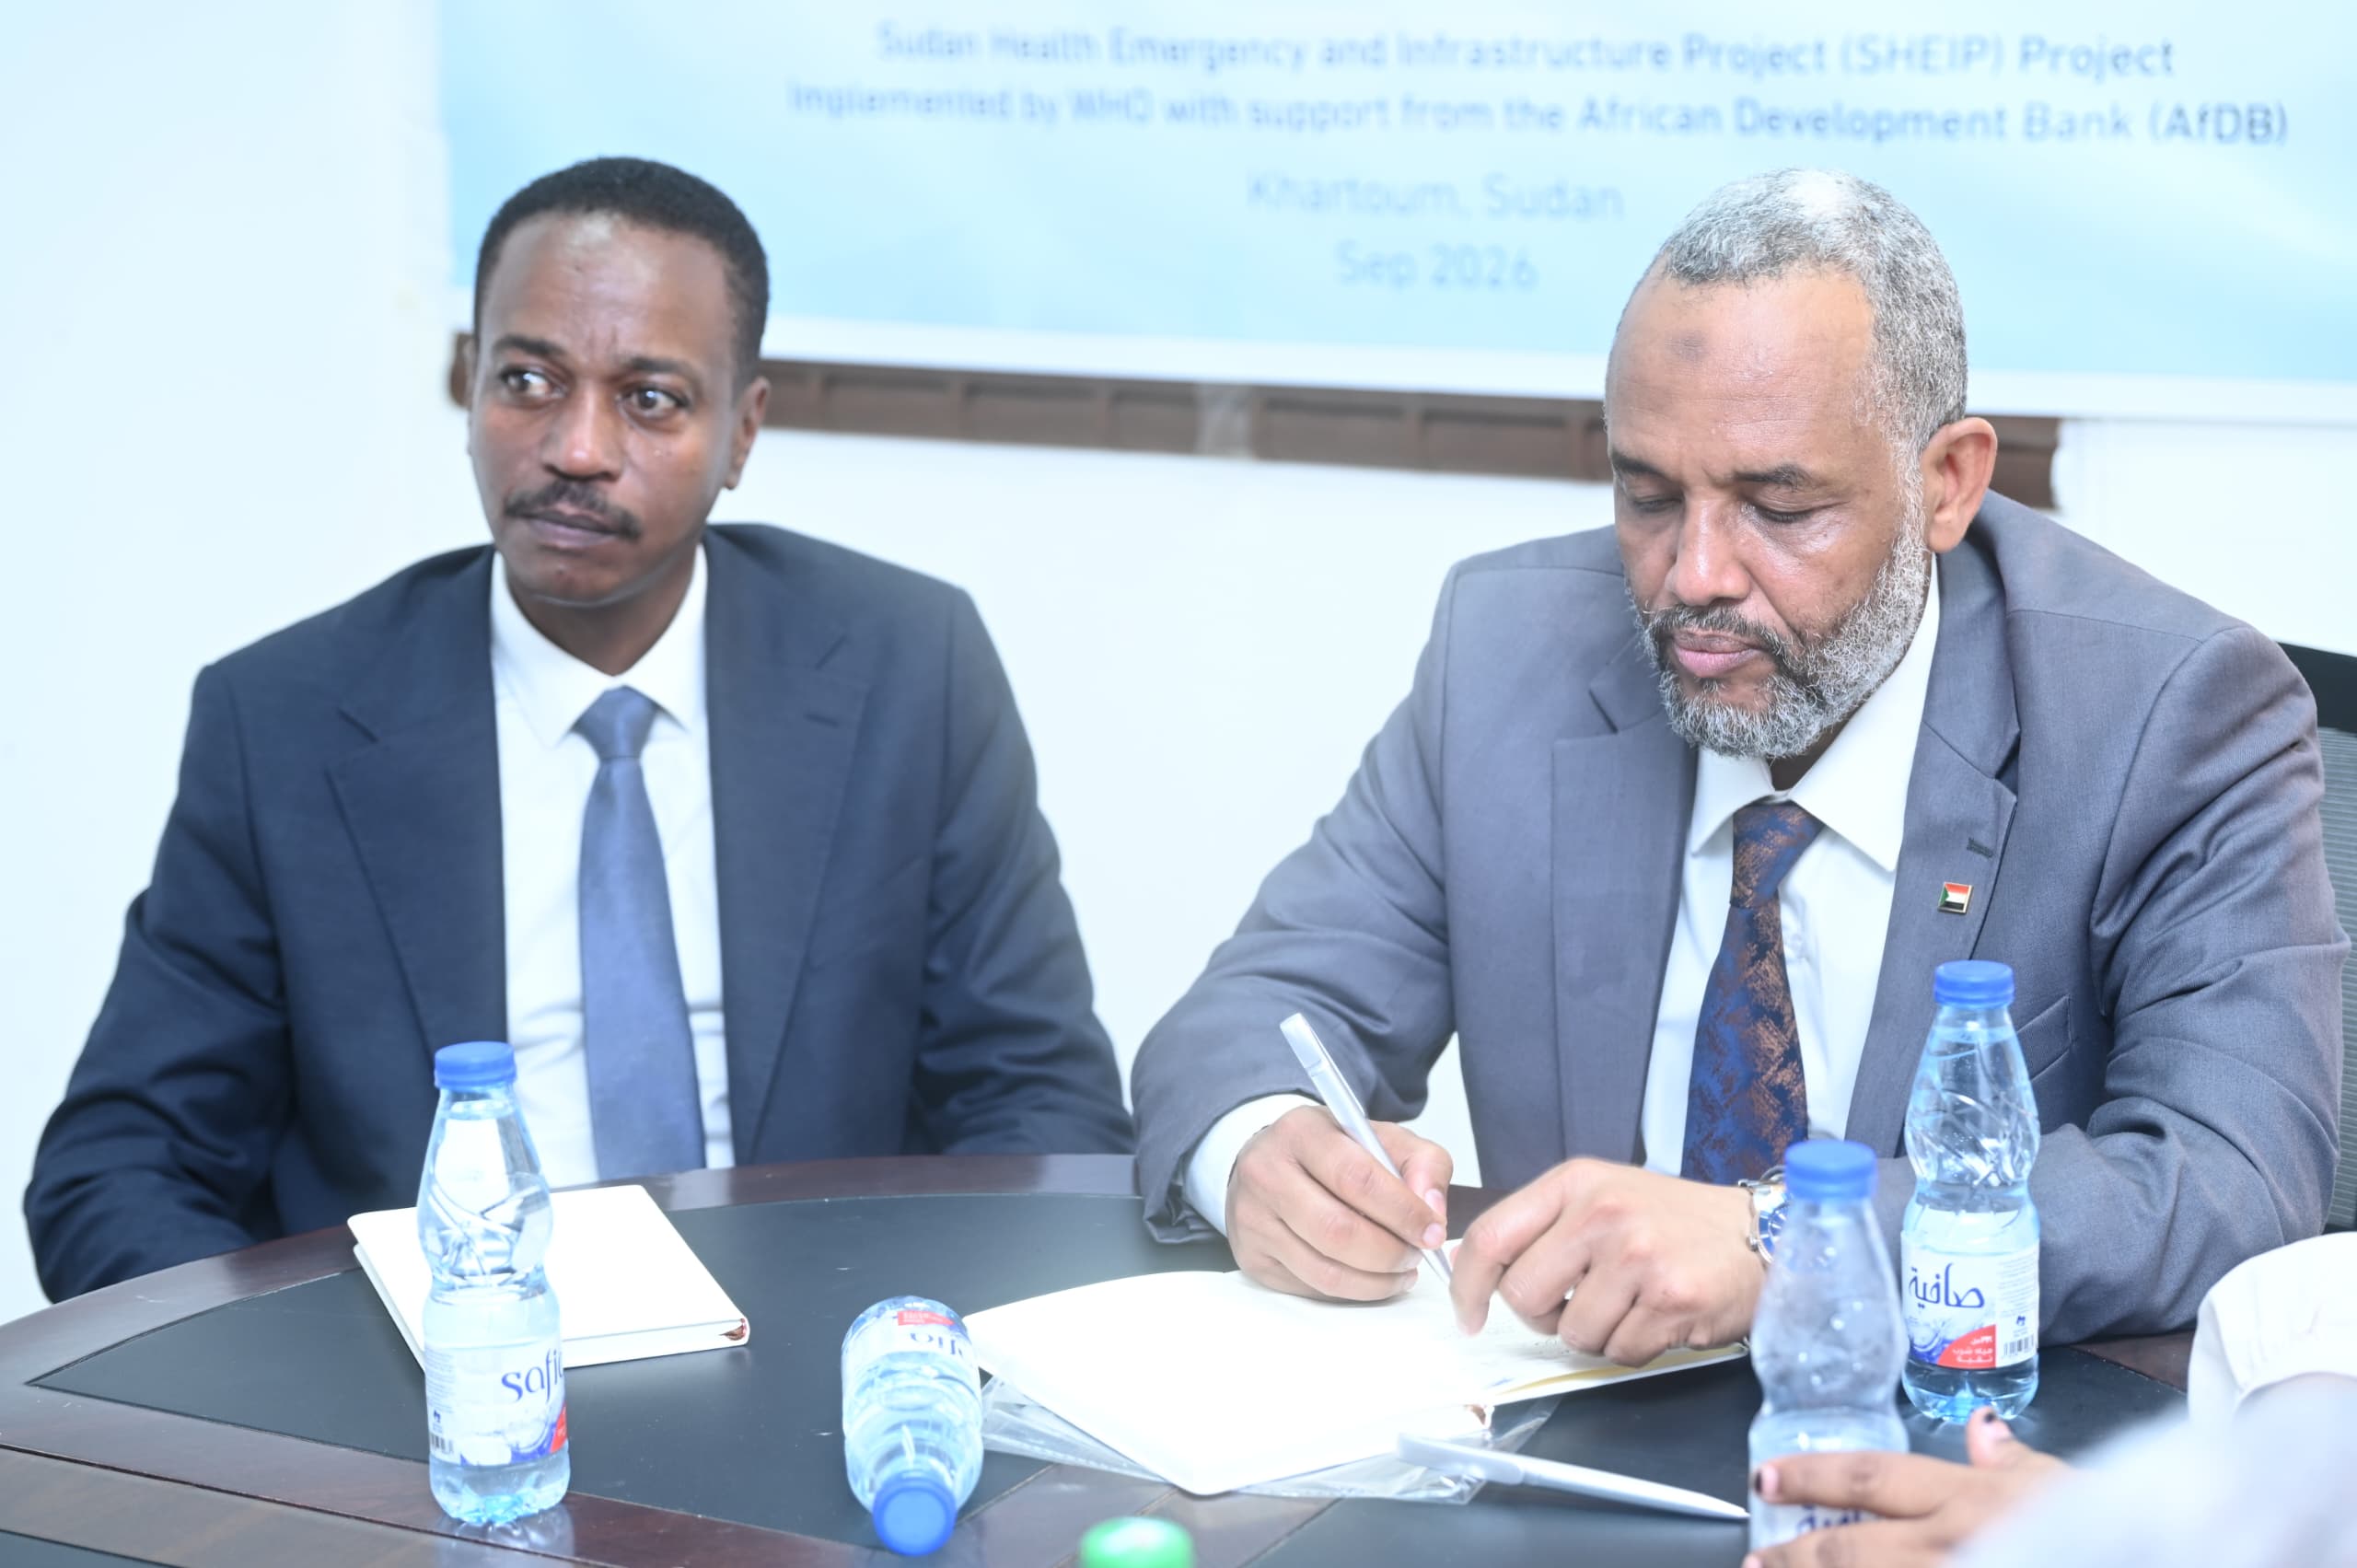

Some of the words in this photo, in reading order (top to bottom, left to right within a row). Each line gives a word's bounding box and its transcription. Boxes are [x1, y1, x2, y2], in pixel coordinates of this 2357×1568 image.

[877, 23, 974, 62] Sudan
[988, 26, 1097, 63] Health
[1109, 28, 1304, 74] Emergency
[1319, 33, 1385, 68] and
[1397, 31, 1670, 70] Infrastructure
[1681, 32, 1826, 80] Project
[1842, 32, 2004, 76] (SHEIP)
[2020, 34, 2176, 84] Project
[787, 80, 1011, 122] Implemented
[1020, 87, 1059, 129] by
[1070, 89, 1154, 126] WHO
[1164, 91, 1237, 127] with
[1249, 95, 1387, 133] support
[1400, 93, 1492, 130] from
[1504, 96, 1564, 131] the
[1576, 97, 1722, 133] African
[1733, 98, 2006, 144] Development
[2023, 101, 2134, 144] Bank
[2148, 100, 2288, 147] (AfDB)
[1248, 172, 1468, 219] Khartoum,
[1482, 172, 1625, 221] Sudan
[1335, 238, 1415, 292] Sep
[1429, 241, 1539, 291] 2026
[1909, 1262, 1985, 1309] صافية
